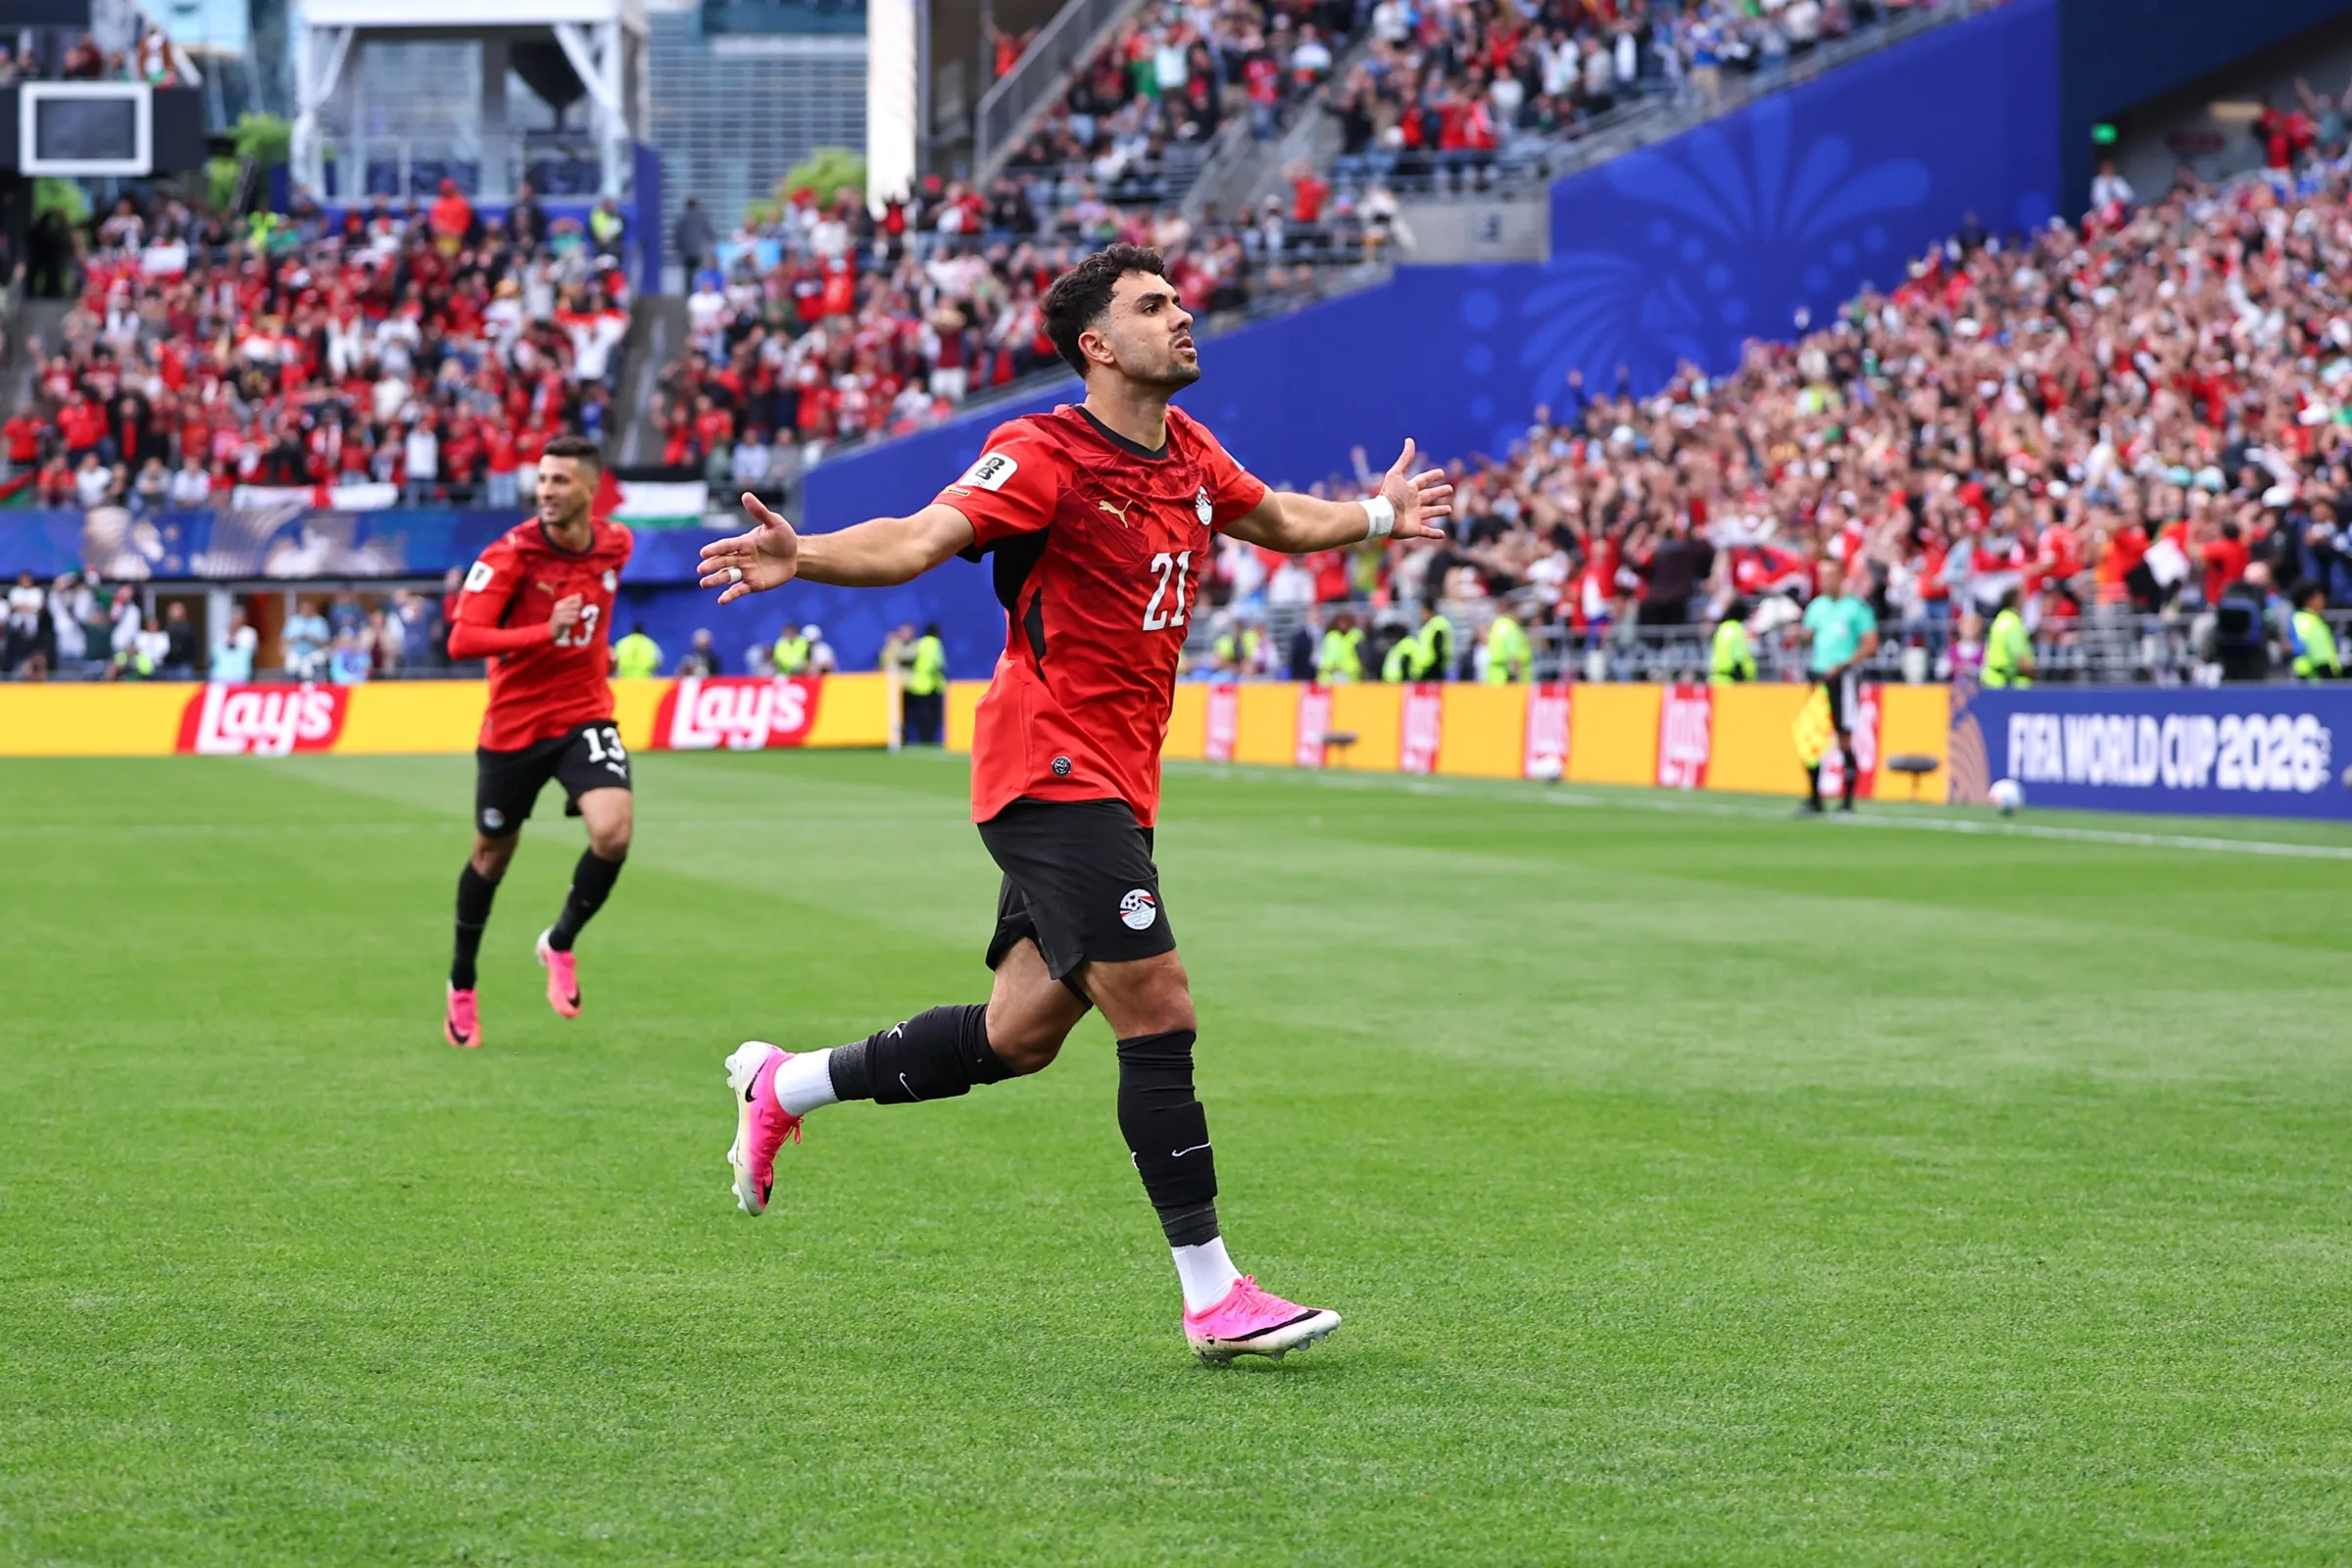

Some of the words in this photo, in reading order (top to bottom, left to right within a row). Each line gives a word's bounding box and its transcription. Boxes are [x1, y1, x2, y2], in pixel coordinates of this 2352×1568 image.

[1142, 550, 1192, 632] 21
[195, 681, 334, 756] Lay's
[583, 726, 626, 763] 13
[668, 675, 808, 751] Lay's
[2008, 712, 2064, 783] FIFA
[2064, 712, 2159, 787] WORLD
[2160, 712, 2218, 789] CUP
[2217, 712, 2322, 793] 2026
